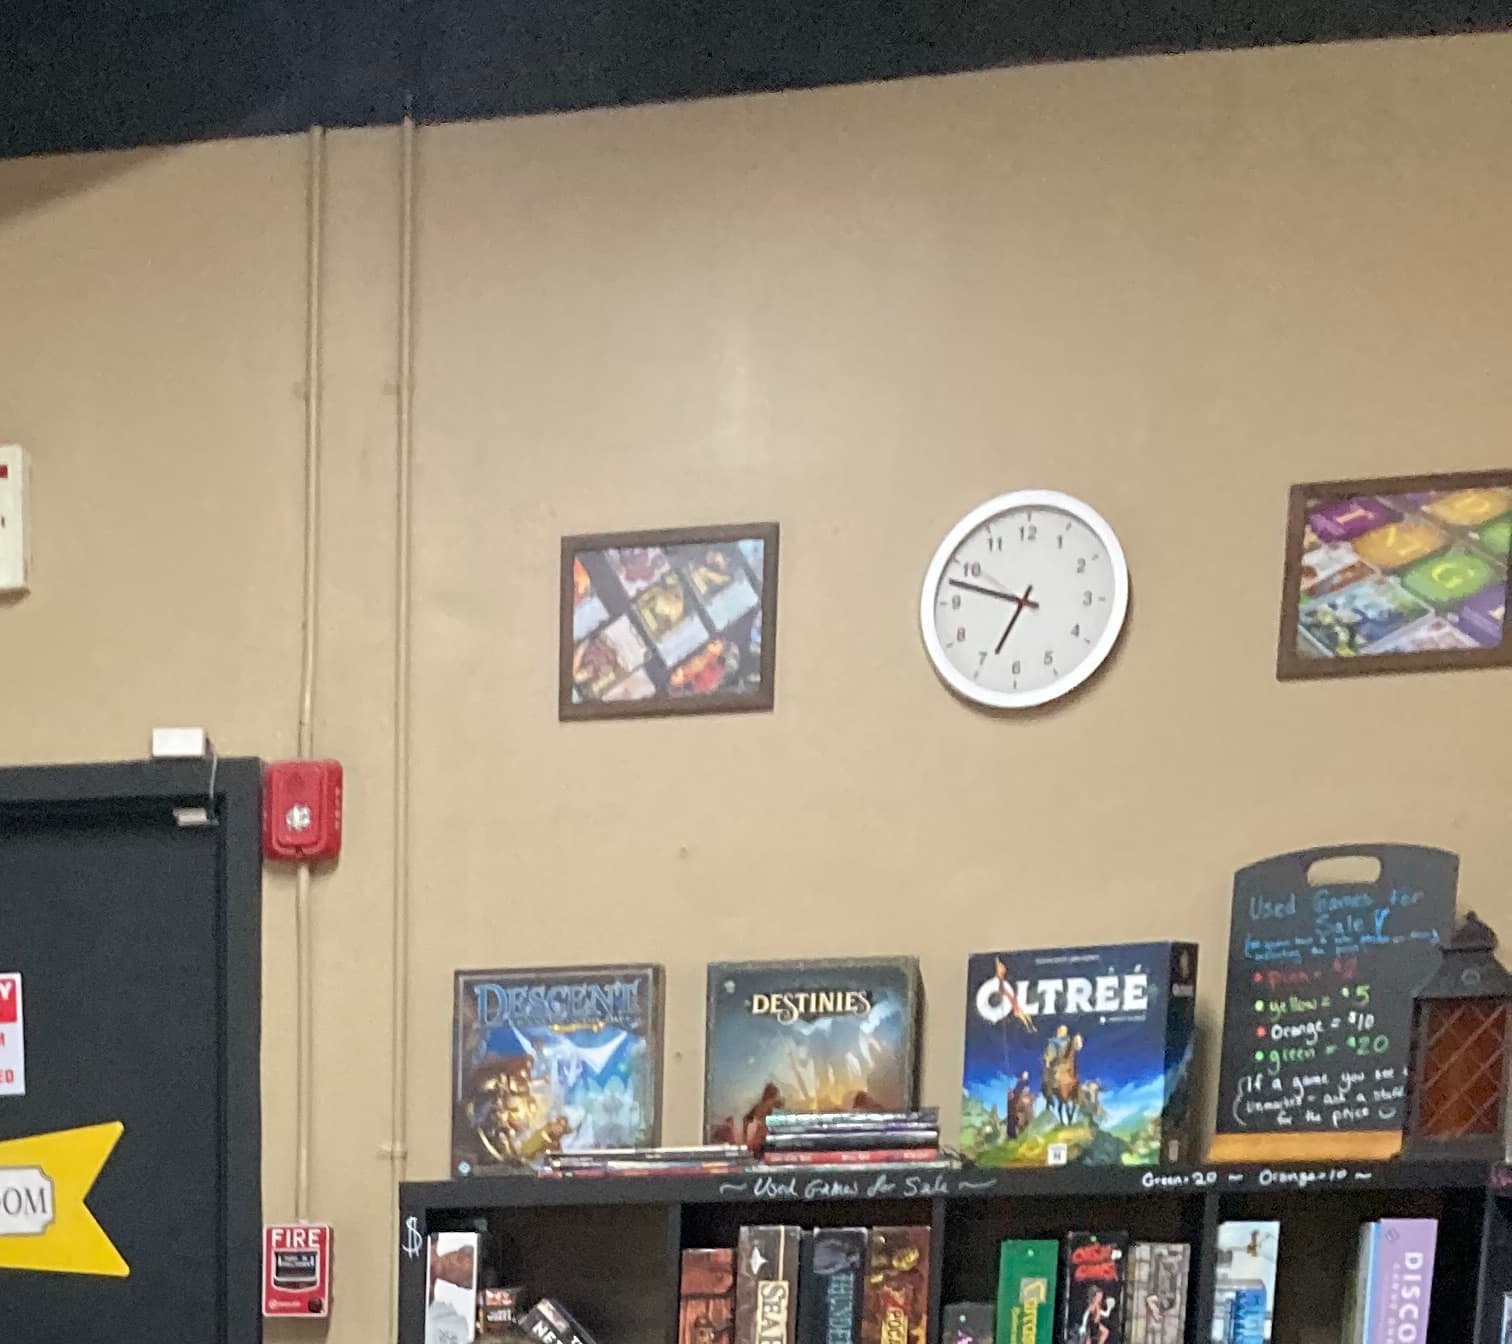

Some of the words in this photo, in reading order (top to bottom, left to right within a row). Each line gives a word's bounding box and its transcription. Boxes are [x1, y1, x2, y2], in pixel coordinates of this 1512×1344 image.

[1019, 525, 1038, 541] 12
[988, 537, 1004, 552] 11
[1056, 535, 1064, 550] 1
[963, 562, 982, 577] 10
[1076, 557, 1086, 574] 2
[951, 595, 962, 609] 9
[1082, 590, 1093, 606] 3
[956, 626, 966, 642] 8
[1070, 624, 1081, 637] 4
[977, 652, 989, 666] 7
[1043, 650, 1054, 666] 5
[1011, 660, 1022, 675] 6
[1249, 892, 1296, 920] Used
[474, 978, 642, 1025] DESCENT
[752, 990, 873, 1025] DESTINIES
[1270, 1020, 1324, 1045] Orange
[1271, 1077, 1283, 1091] a
[1338, 1072, 1365, 1093] you
[1332, 1107, 1370, 1128] price
[271, 1228, 321, 1249] FIRE
[402, 1215, 423, 1261] $
